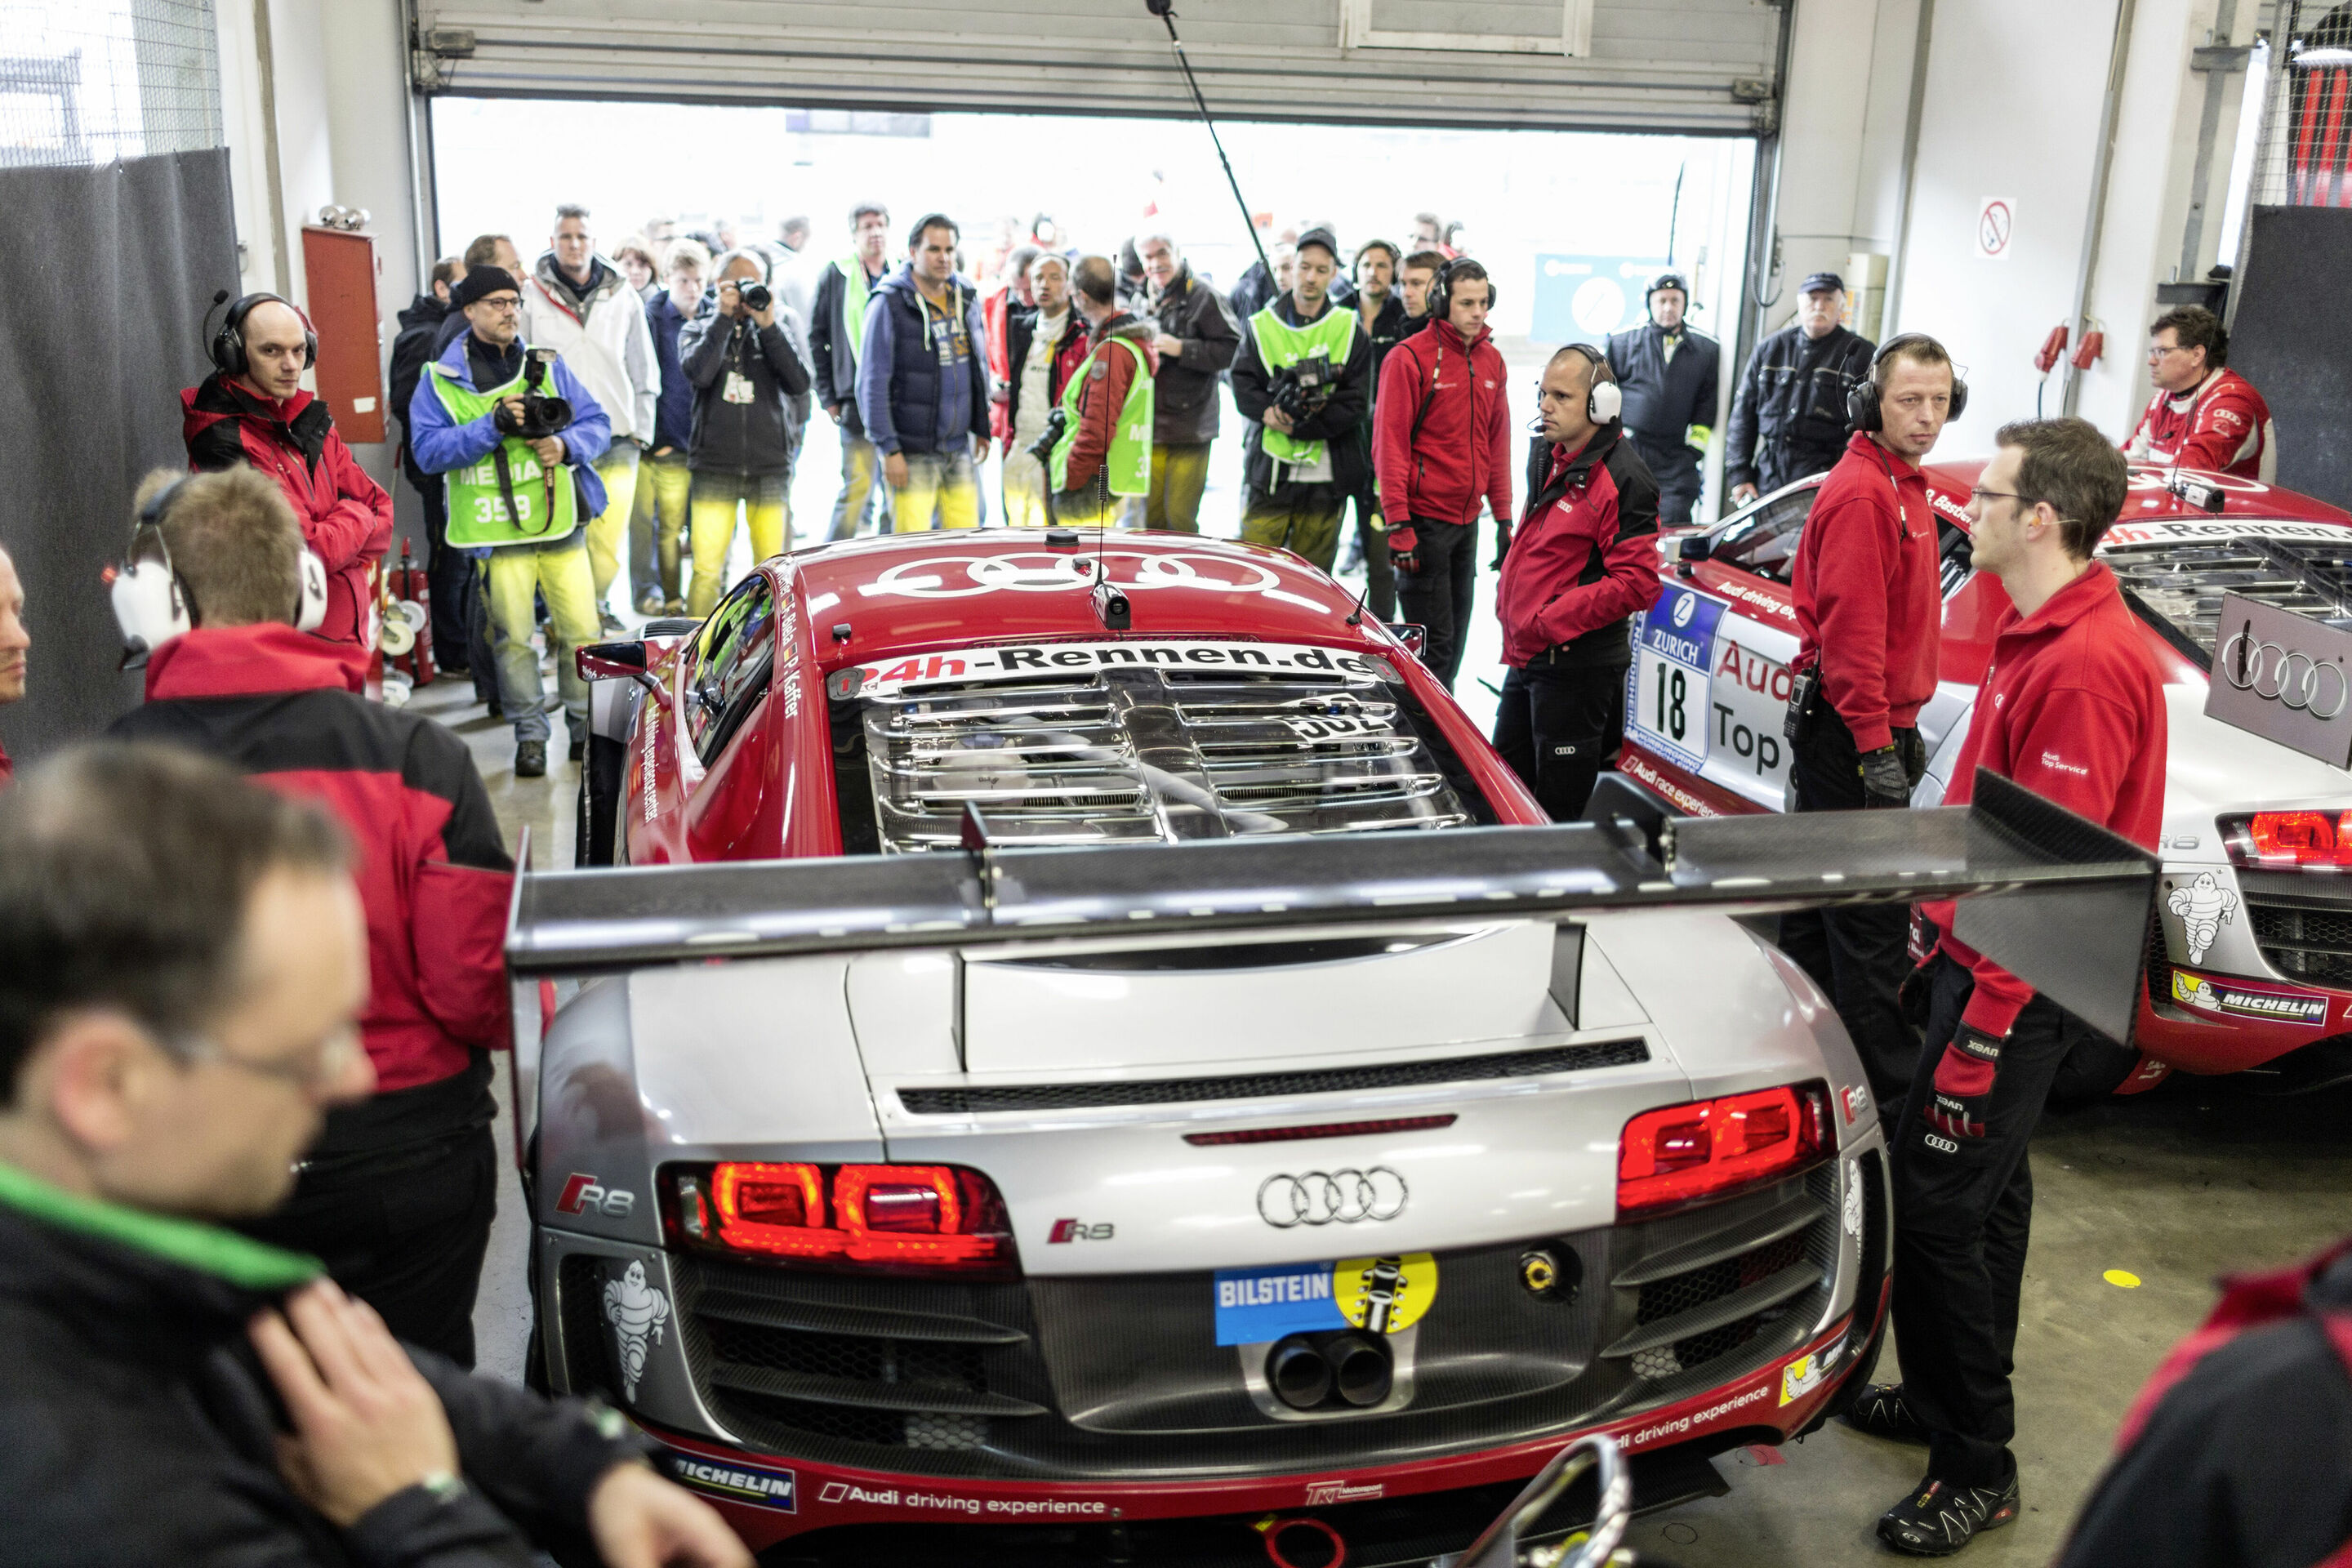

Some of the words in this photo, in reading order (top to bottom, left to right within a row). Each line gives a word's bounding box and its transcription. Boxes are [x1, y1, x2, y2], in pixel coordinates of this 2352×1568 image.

[460, 460, 543, 486] MEIA
[474, 494, 531, 523] 359
[1717, 581, 1747, 599] Audi
[1742, 590, 1784, 613] driving
[1653, 629, 1699, 665] ZURICH
[1716, 640, 1791, 702] Aud
[784, 670, 803, 719] Kaffer
[1657, 662, 1686, 742] 18
[1713, 702, 1780, 775] Top
[2041, 757, 2054, 768] Top
[2042, 751, 2060, 761] Audi
[1633, 761, 1658, 785] Audi
[1655, 777, 1675, 798] race
[2223, 993, 2325, 1014] MICHELIN
[1967, 1040, 1999, 1057] uvex
[1845, 1085, 1869, 1113] R8
[571, 1183, 635, 1216] R8
[1060, 1222, 1114, 1240] R8
[1219, 1272, 1329, 1308] BILSTEIN
[1634, 1416, 1689, 1444] driving
[1693, 1386, 1769, 1423] experience
[849, 1486, 898, 1506] Audi
[906, 1493, 980, 1514] driving
[987, 1498, 1105, 1516] experience
[1342, 1483, 1383, 1494] Motorsport
